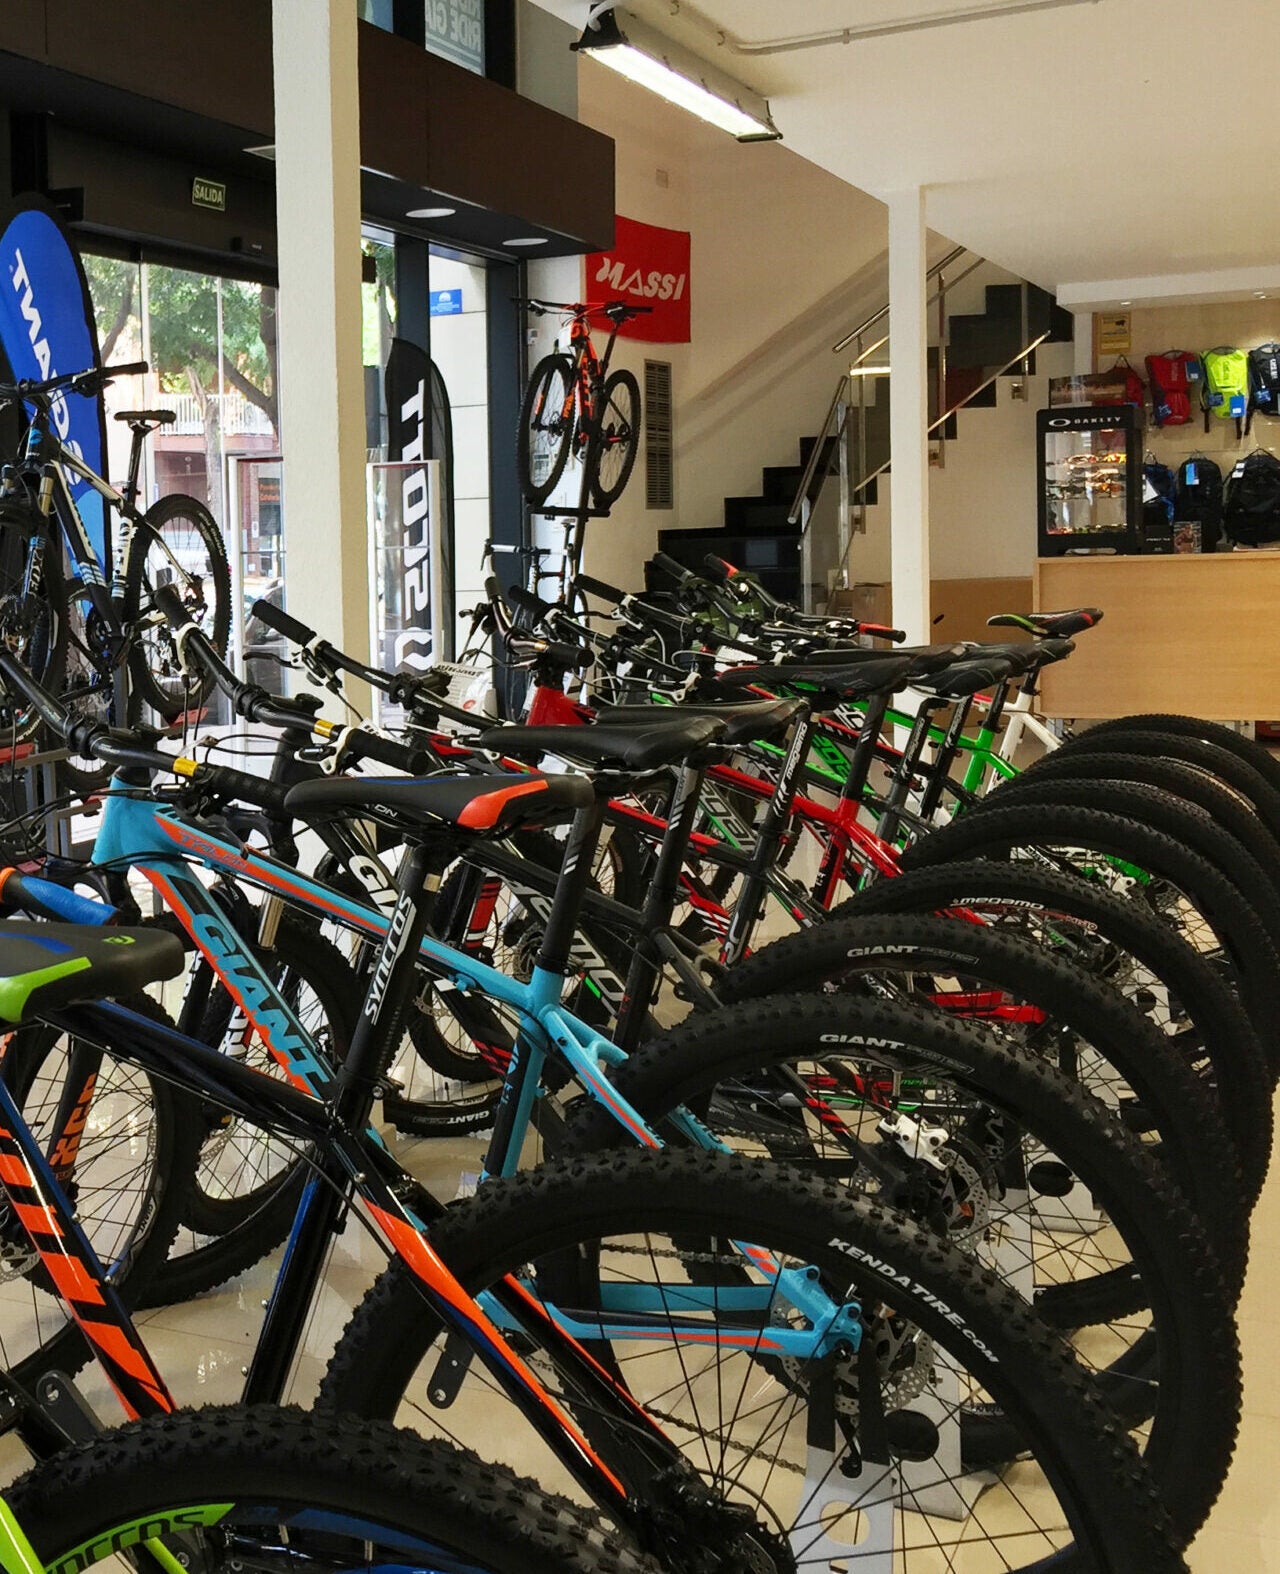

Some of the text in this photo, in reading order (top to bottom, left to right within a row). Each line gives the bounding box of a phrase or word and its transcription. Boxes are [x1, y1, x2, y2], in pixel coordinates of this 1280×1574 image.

[194, 184, 223, 204] SALIDA
[596, 256, 686, 300] MASSI
[1074, 416, 1121, 426] OAKLEY
[847, 944, 919, 958] GIANT
[193, 914, 328, 1100] GIANT
[819, 1033, 906, 1050] GIANT
[447, 1109, 490, 1125] GIANT
[827, 1237, 1000, 1363] KENDATIRE.COM
